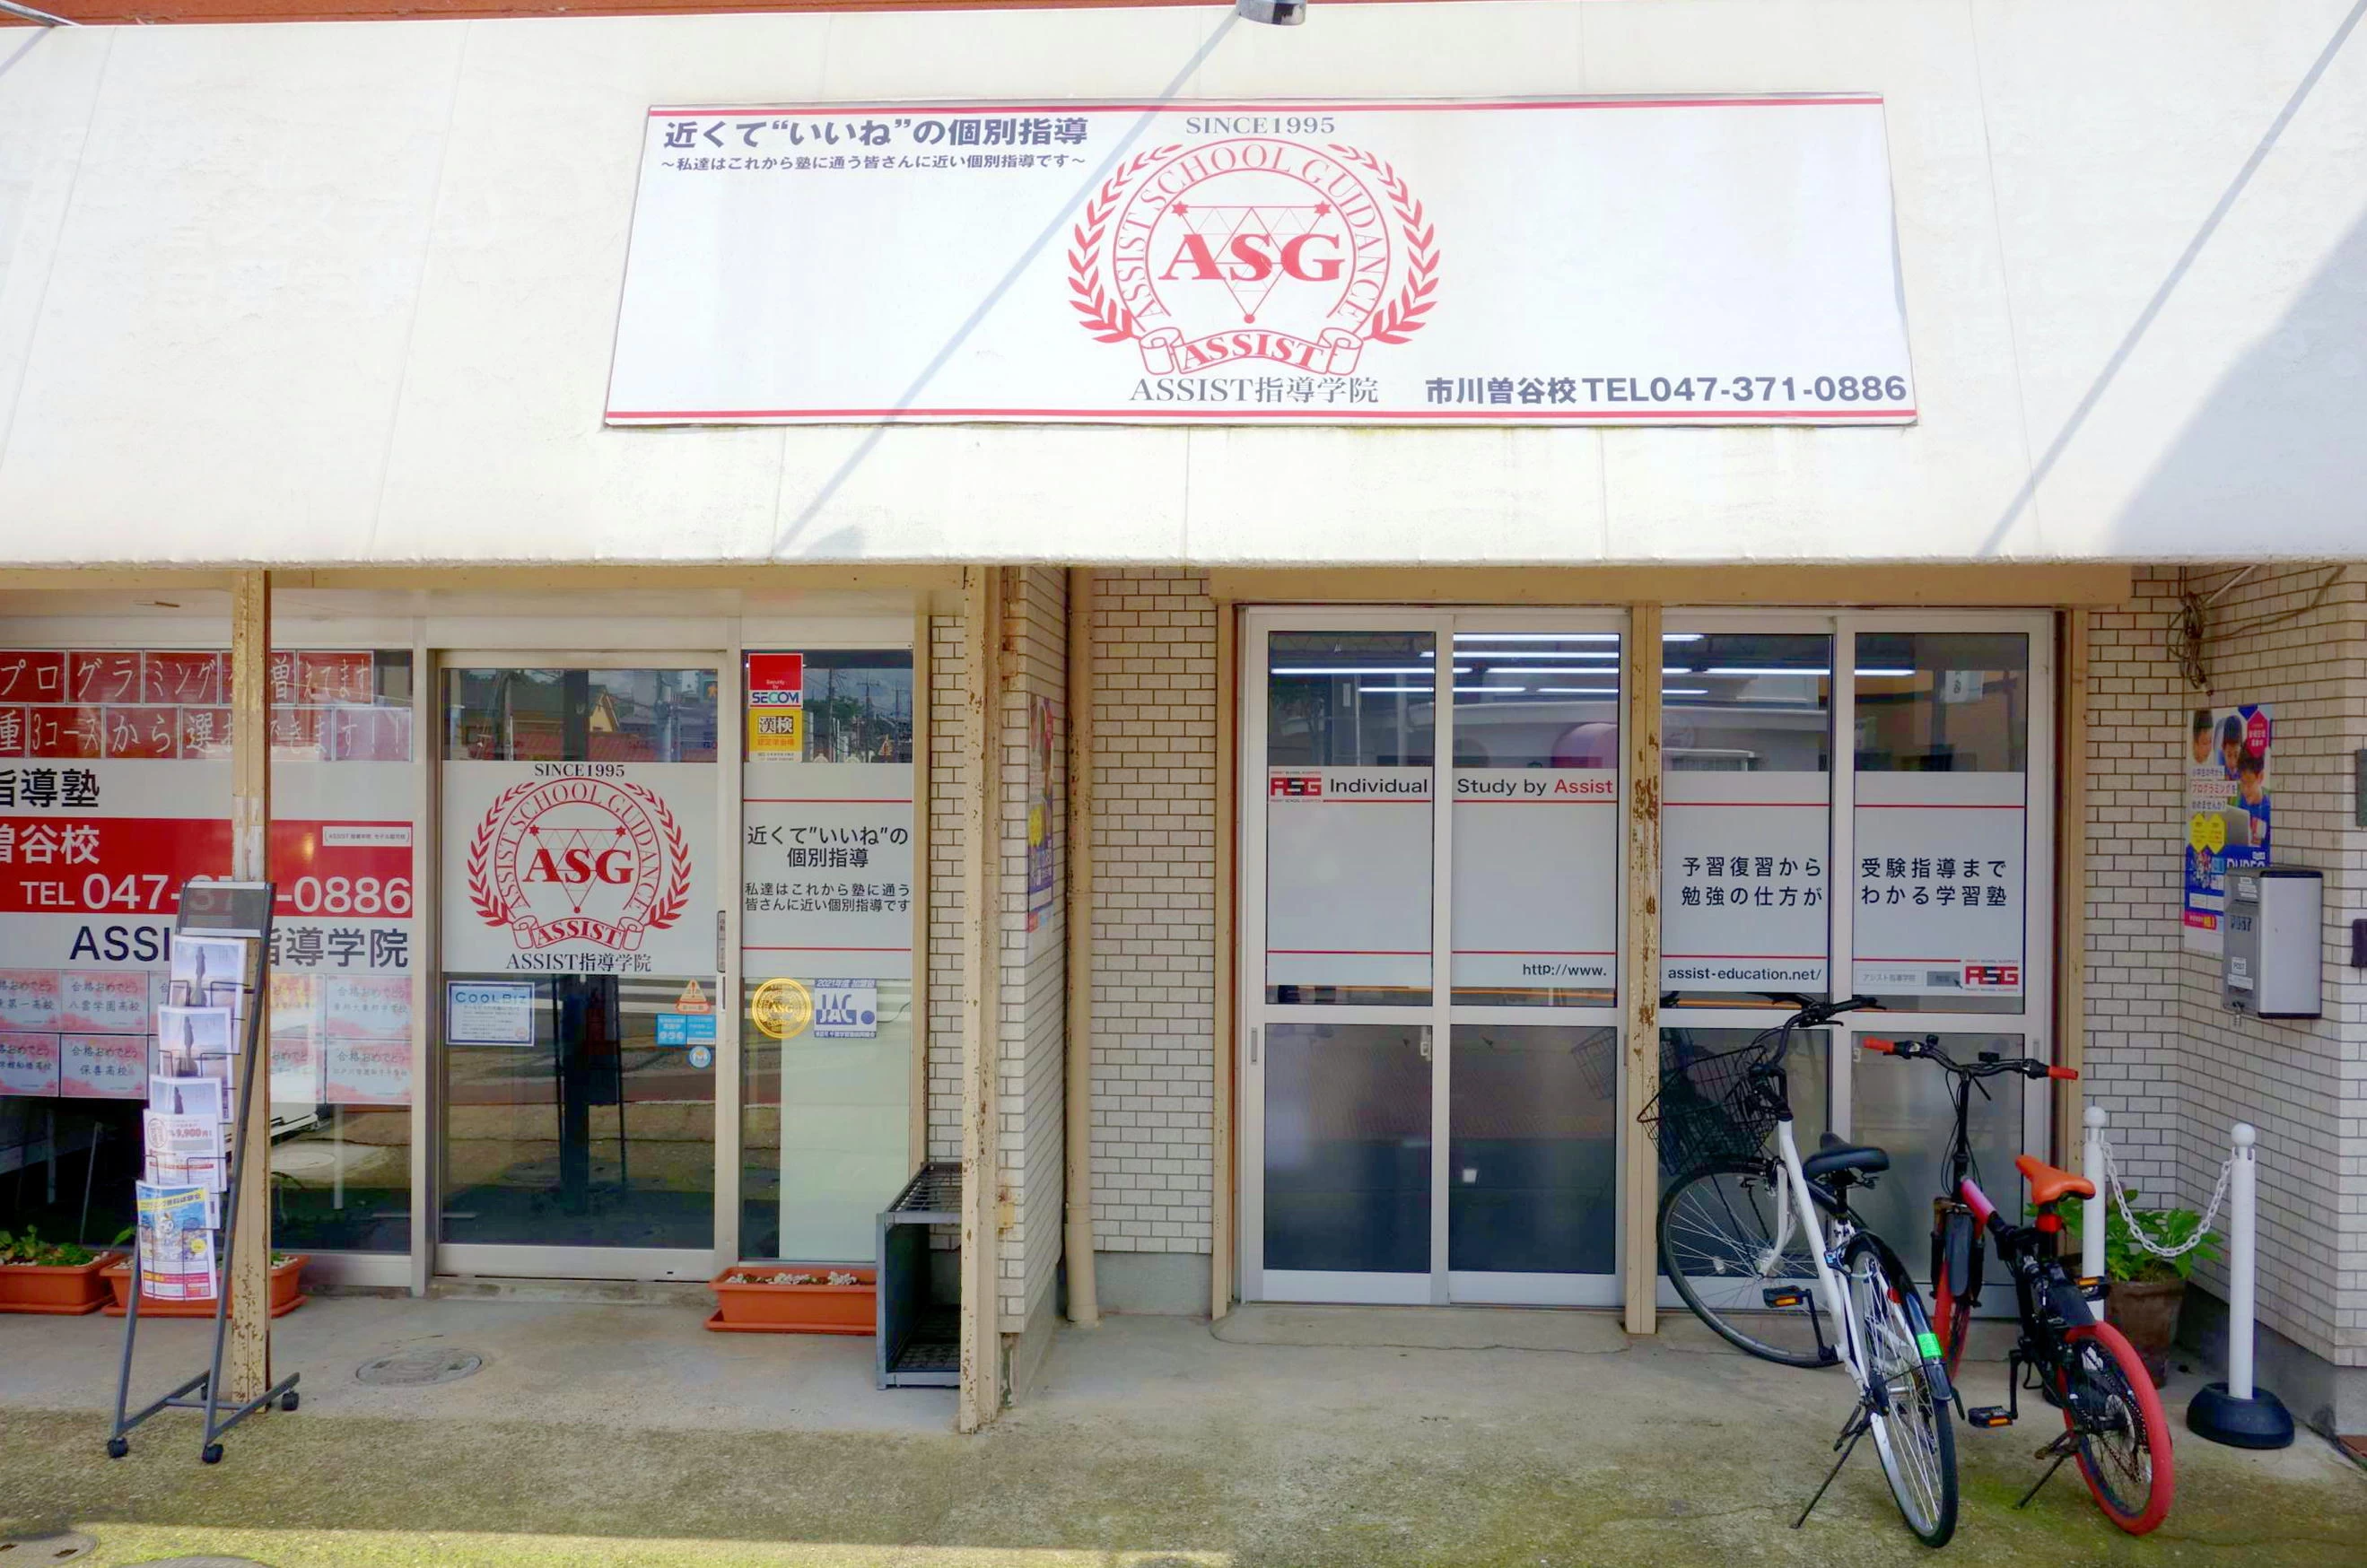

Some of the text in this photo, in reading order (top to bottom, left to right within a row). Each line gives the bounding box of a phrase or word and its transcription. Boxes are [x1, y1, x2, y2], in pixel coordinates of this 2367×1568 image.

[663, 118, 1088, 148] 近くて“いいね”の個別指導
[1185, 117, 1335, 135] SINCE1995
[1116, 143, 1384, 324] ASSIST SCHOOL GUIDANCE
[1157, 232, 1346, 282] ASG
[1182, 333, 1325, 370] ASSIST
[1128, 376, 1379, 404] ASSIST指導学院
[1, 653, 370, 700] プログラミング増えてます
[752, 692, 799, 704] SECOM
[758, 716, 794, 735] 漢検
[534, 763, 625, 778] SINCE1995
[1330, 778, 1428, 793] Individual
[1457, 778, 1516, 797] Study
[1524, 779, 1548, 797] by
[1554, 779, 1613, 794] Assist
[496, 780, 659, 914] ASSIST SCHOOL GUIDANCE
[786, 848, 869, 867] 個別指導
[522, 848, 634, 884] ASG
[1681, 857, 1821, 878] 予習復習から
[1860, 858, 2007, 878] 受験指導まで
[20, 873, 412, 914] TEL 047-3-0886
[744, 882, 910, 897] 私達はこれから塾に通う
[1681, 884, 1822, 906] 勉強の仕方が
[1860, 884, 2007, 907] わかる学習塾
[744, 898, 911, 912] 皆さんに近い個別指導です
[537, 920, 624, 946] ASSIST
[69, 926, 409, 969] ASSI導学院
[505, 953, 652, 972] ASSIST指導学院
[1523, 963, 1607, 977] http://www.
[1668, 968, 1822, 981] assist-education.net/
